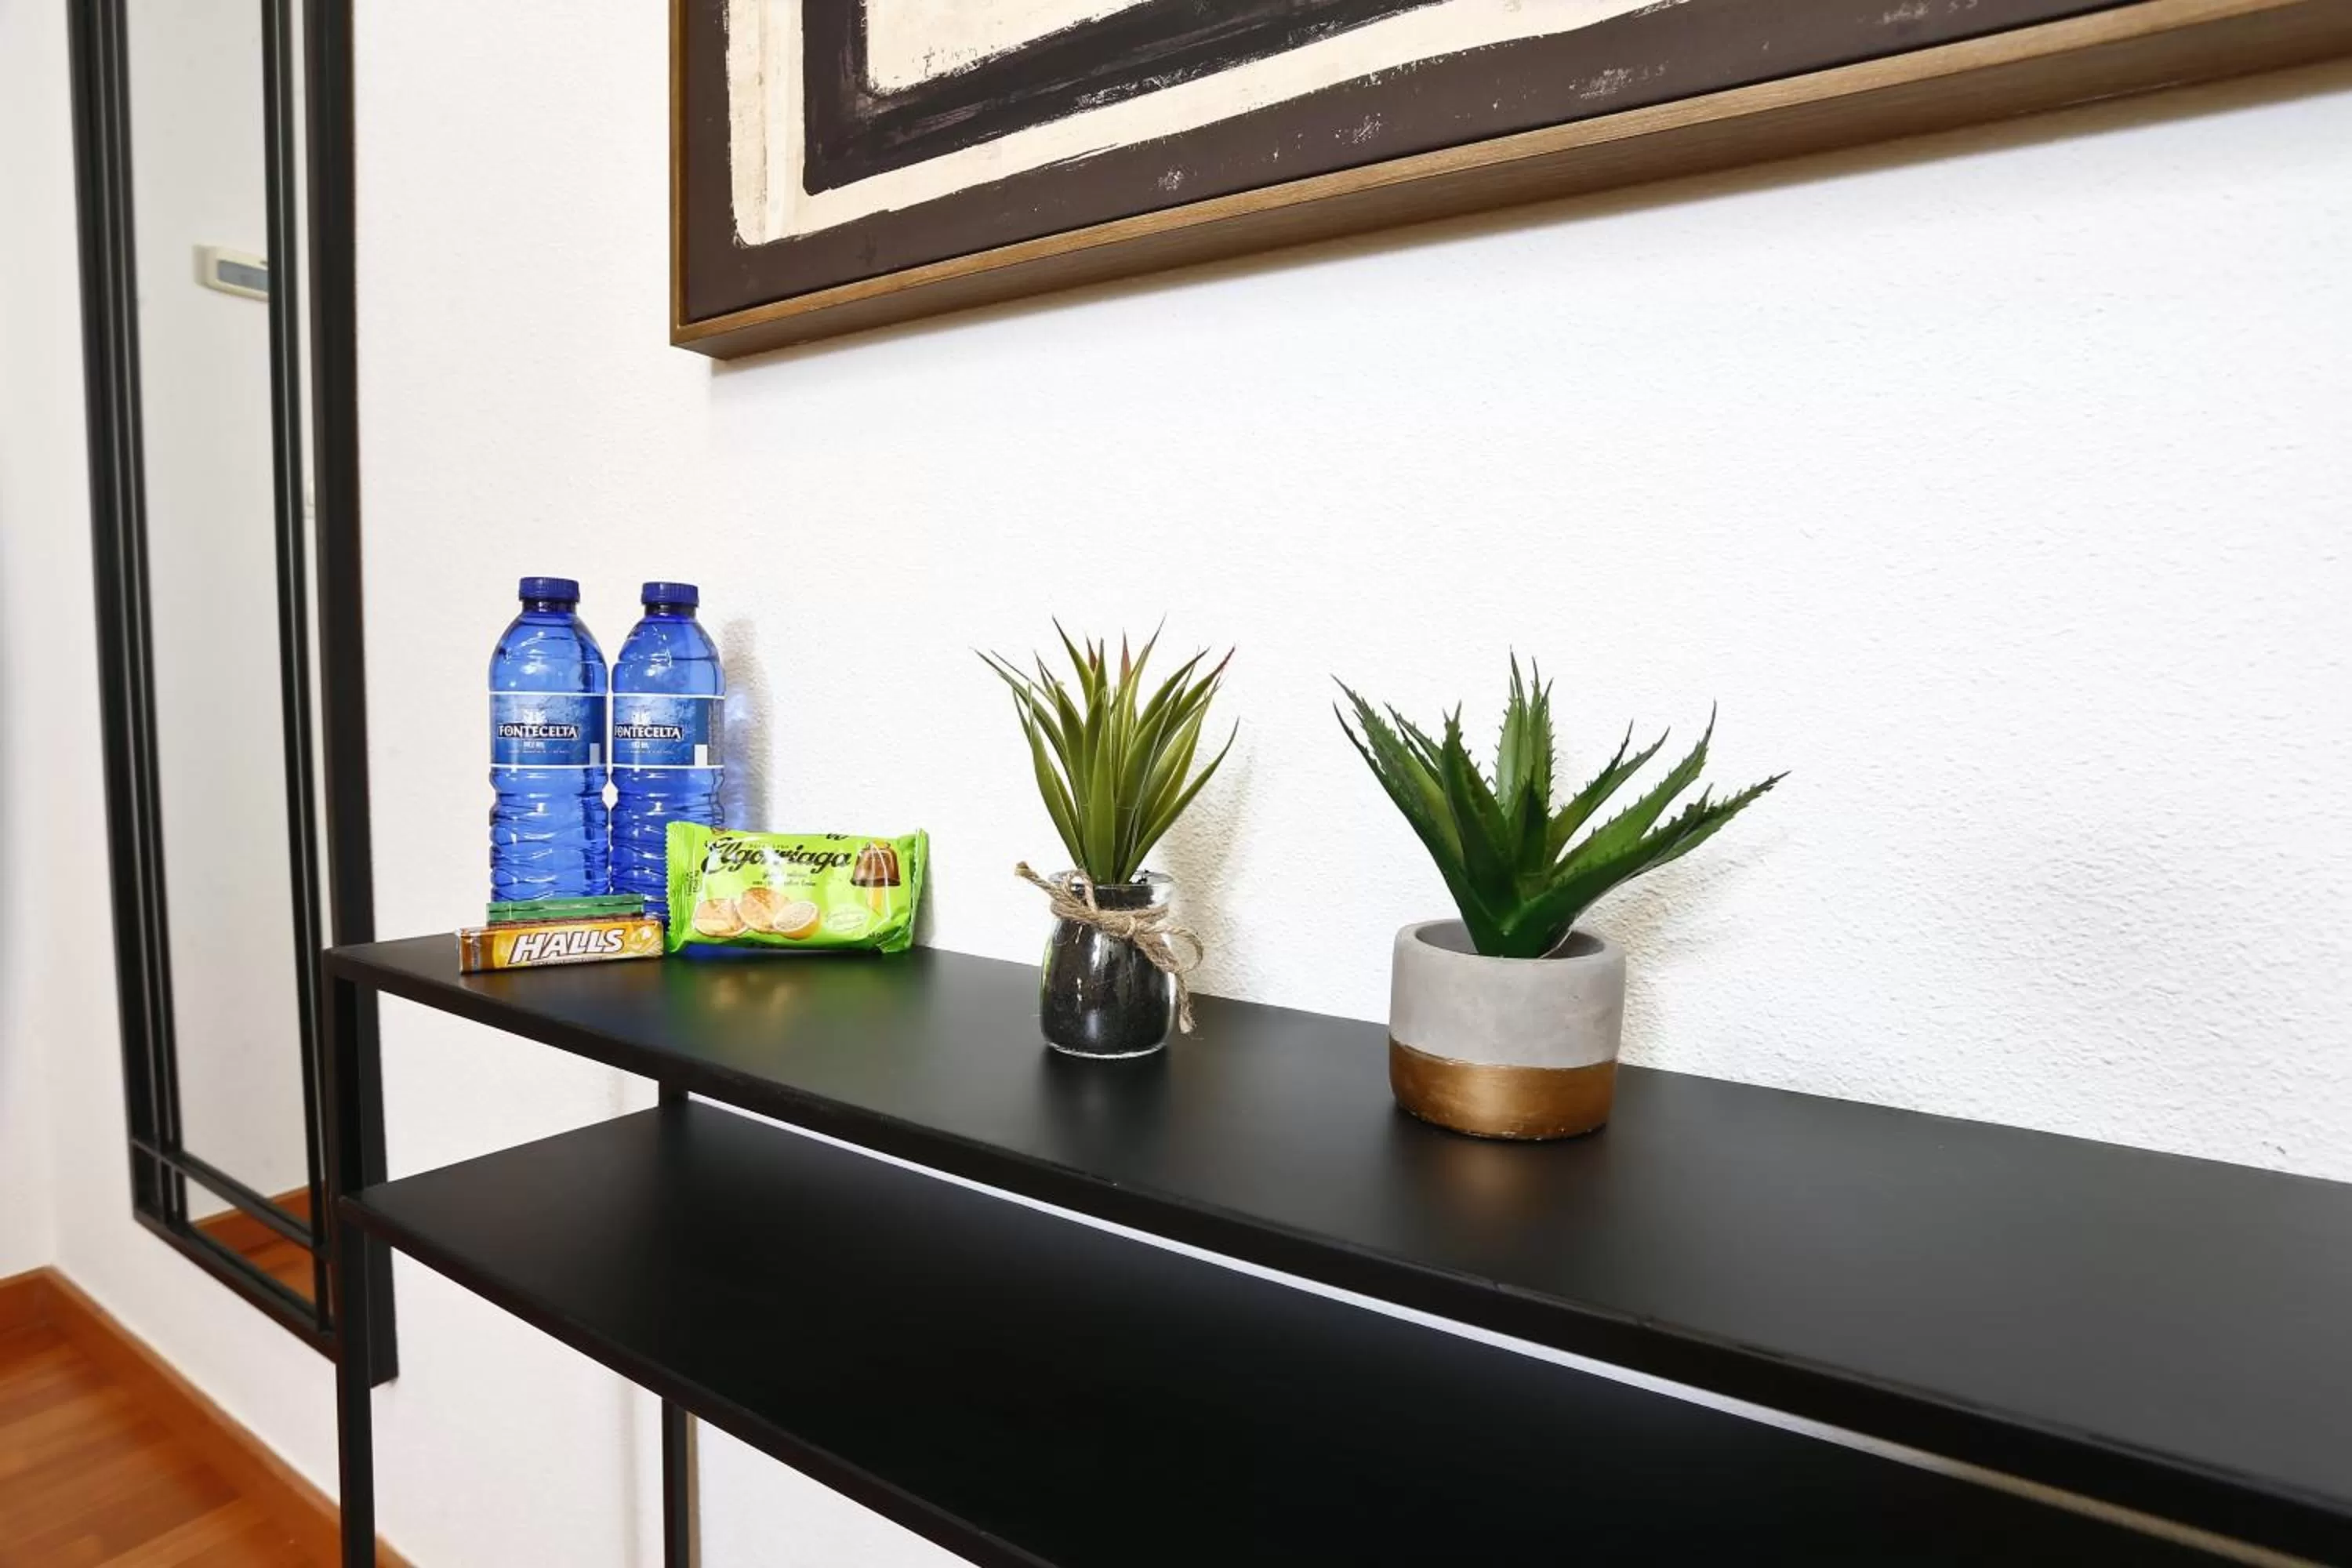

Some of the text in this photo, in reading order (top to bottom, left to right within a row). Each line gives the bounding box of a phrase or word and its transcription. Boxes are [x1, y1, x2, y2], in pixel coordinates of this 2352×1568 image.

[498, 724, 579, 739] FONTECELTA
[614, 725, 682, 741] FONTECELTA
[700, 837, 852, 874] Elgoriaga
[507, 929, 625, 964] HALLS
